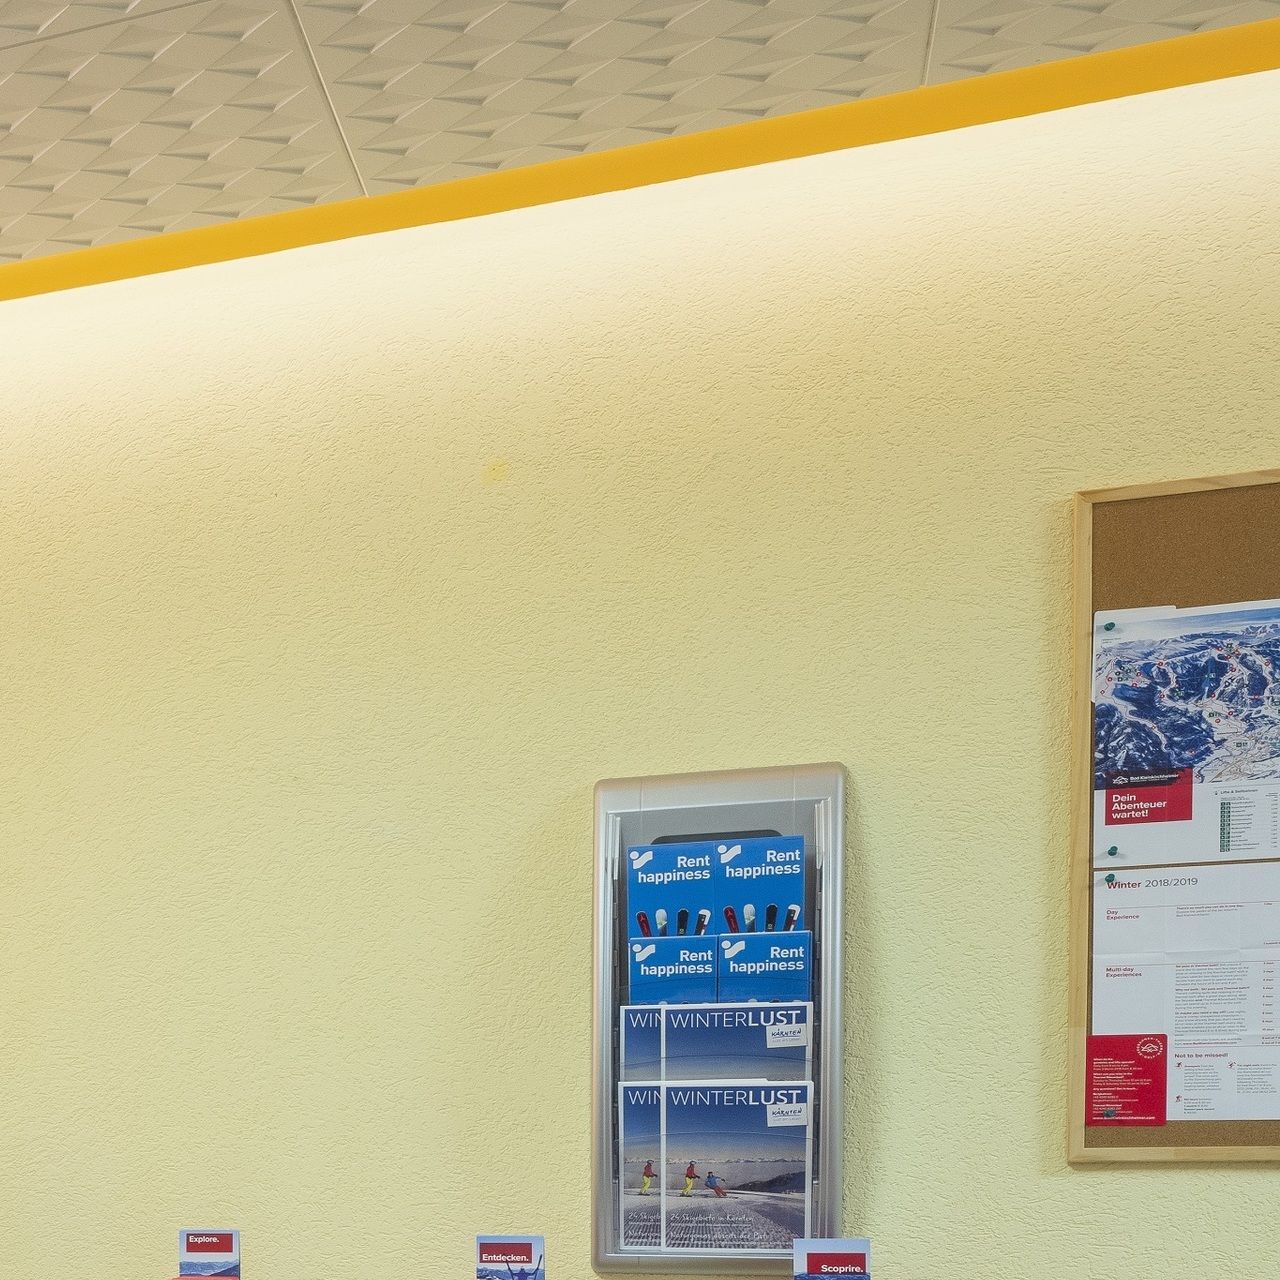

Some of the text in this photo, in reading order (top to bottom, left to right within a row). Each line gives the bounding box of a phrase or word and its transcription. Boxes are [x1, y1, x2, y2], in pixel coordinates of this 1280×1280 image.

[1112, 793, 1137, 802] Dein
[1111, 801, 1168, 811] Abenteuer
[1111, 810, 1149, 819] wartet!
[677, 855, 711, 868] Rent
[766, 849, 801, 862] Rent
[638, 869, 711, 885] happiness
[725, 863, 801, 879] happiness
[1106, 877, 1198, 889] Winter 2018/2019
[680, 949, 713, 962] Rent
[770, 946, 805, 958] Rent
[640, 962, 713, 977] happiness
[729, 960, 805, 974] happiness
[670, 1010, 801, 1028] WINTERLUST
[671, 1090, 802, 1106] WINTERLUST
[189, 1235, 220, 1244] Explore.
[482, 1253, 529, 1262] Entdecken.
[821, 1264, 864, 1273] Scoprire.
